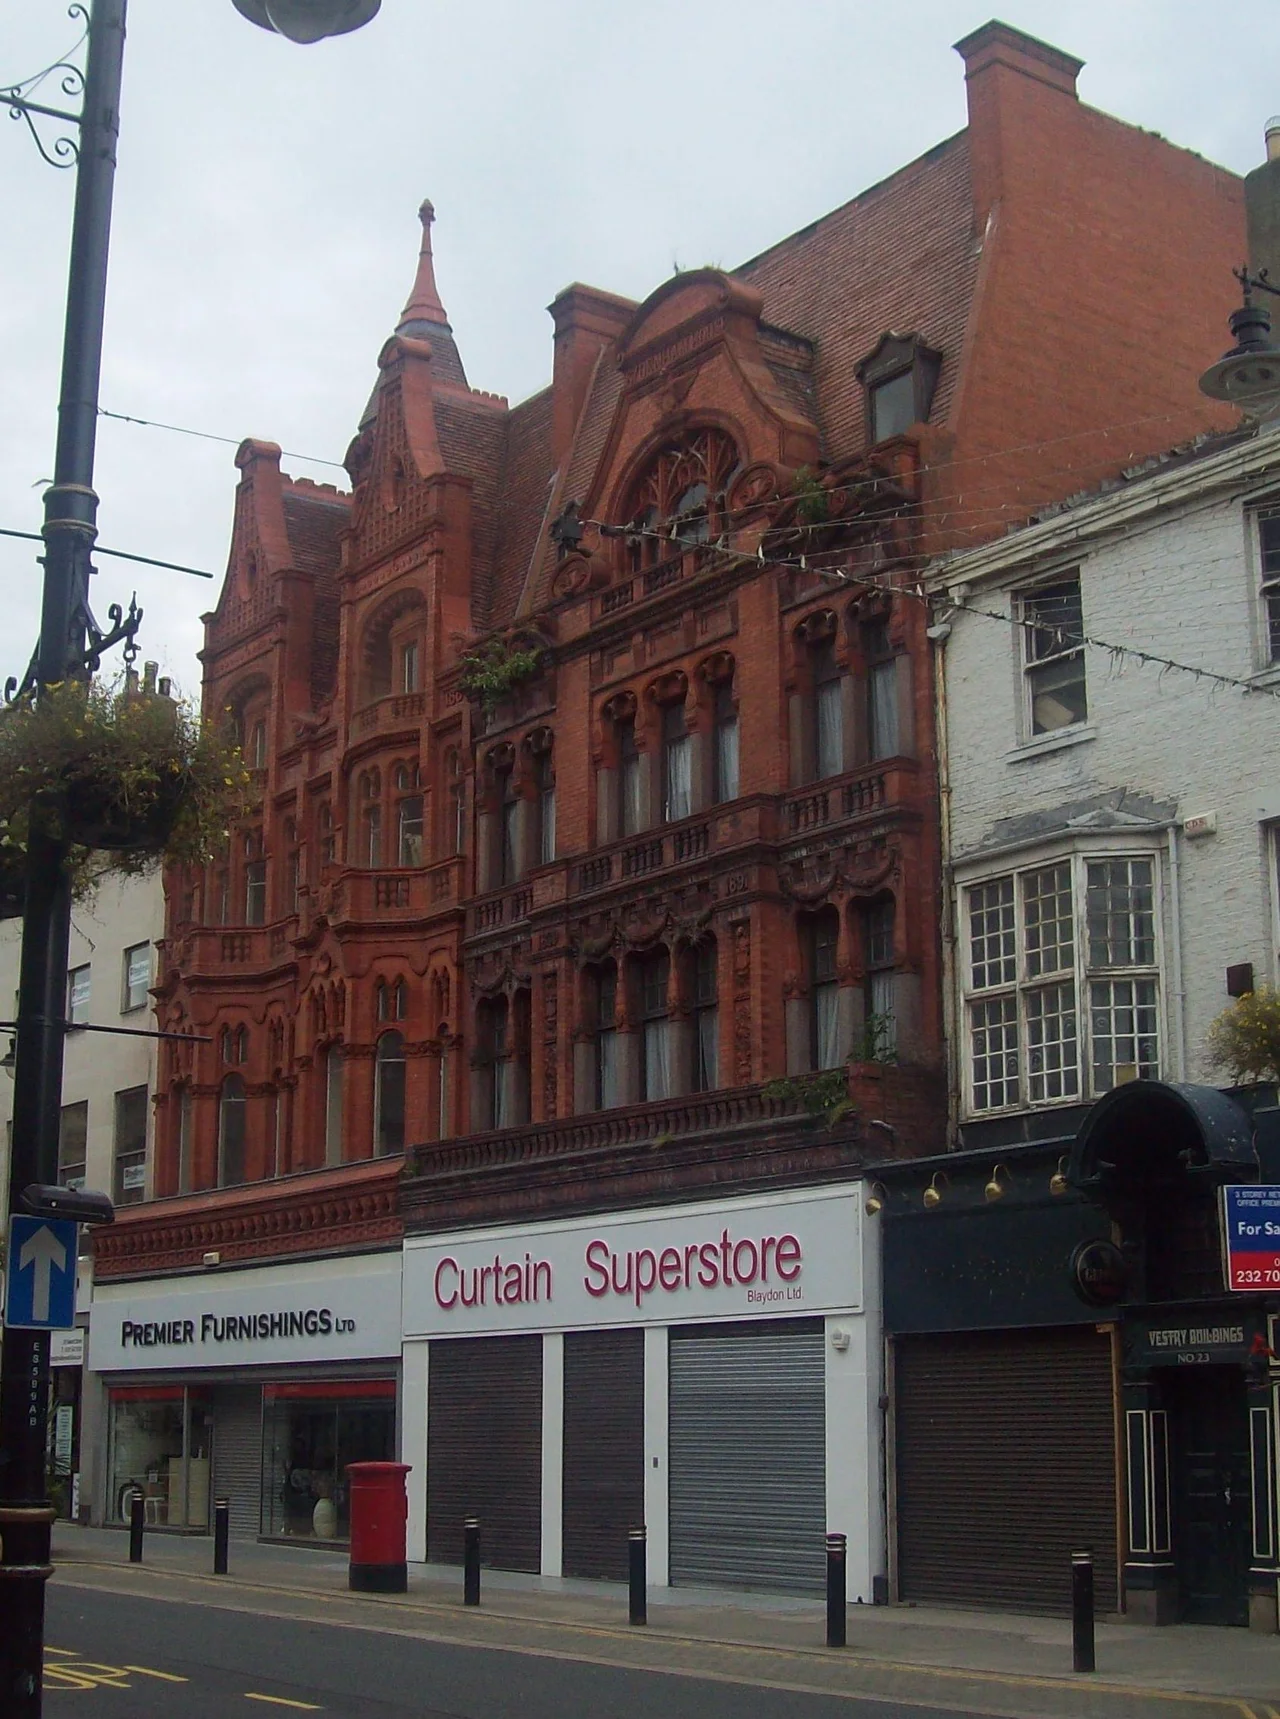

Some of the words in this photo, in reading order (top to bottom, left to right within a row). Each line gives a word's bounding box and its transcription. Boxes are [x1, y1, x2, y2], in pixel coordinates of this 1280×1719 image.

[1236, 1199, 1260, 1207] OFFICE
[1237, 1221, 1261, 1236] For
[1264, 1221, 1280, 1236] Sa
[434, 1252, 552, 1310] Curtain
[584, 1228, 803, 1309] Superstore
[1236, 1270, 1261, 1283] 232
[1264, 1269, 1280, 1283] 70
[747, 1288, 784, 1306] Blaydon
[121, 1319, 195, 1348] PREMIER
[200, 1308, 333, 1343] FURNISHINGS
[1148, 1329, 1188, 1347] VESTRY
[1177, 1353, 1195, 1364] NO
[1197, 1352, 1211, 1363] 23
